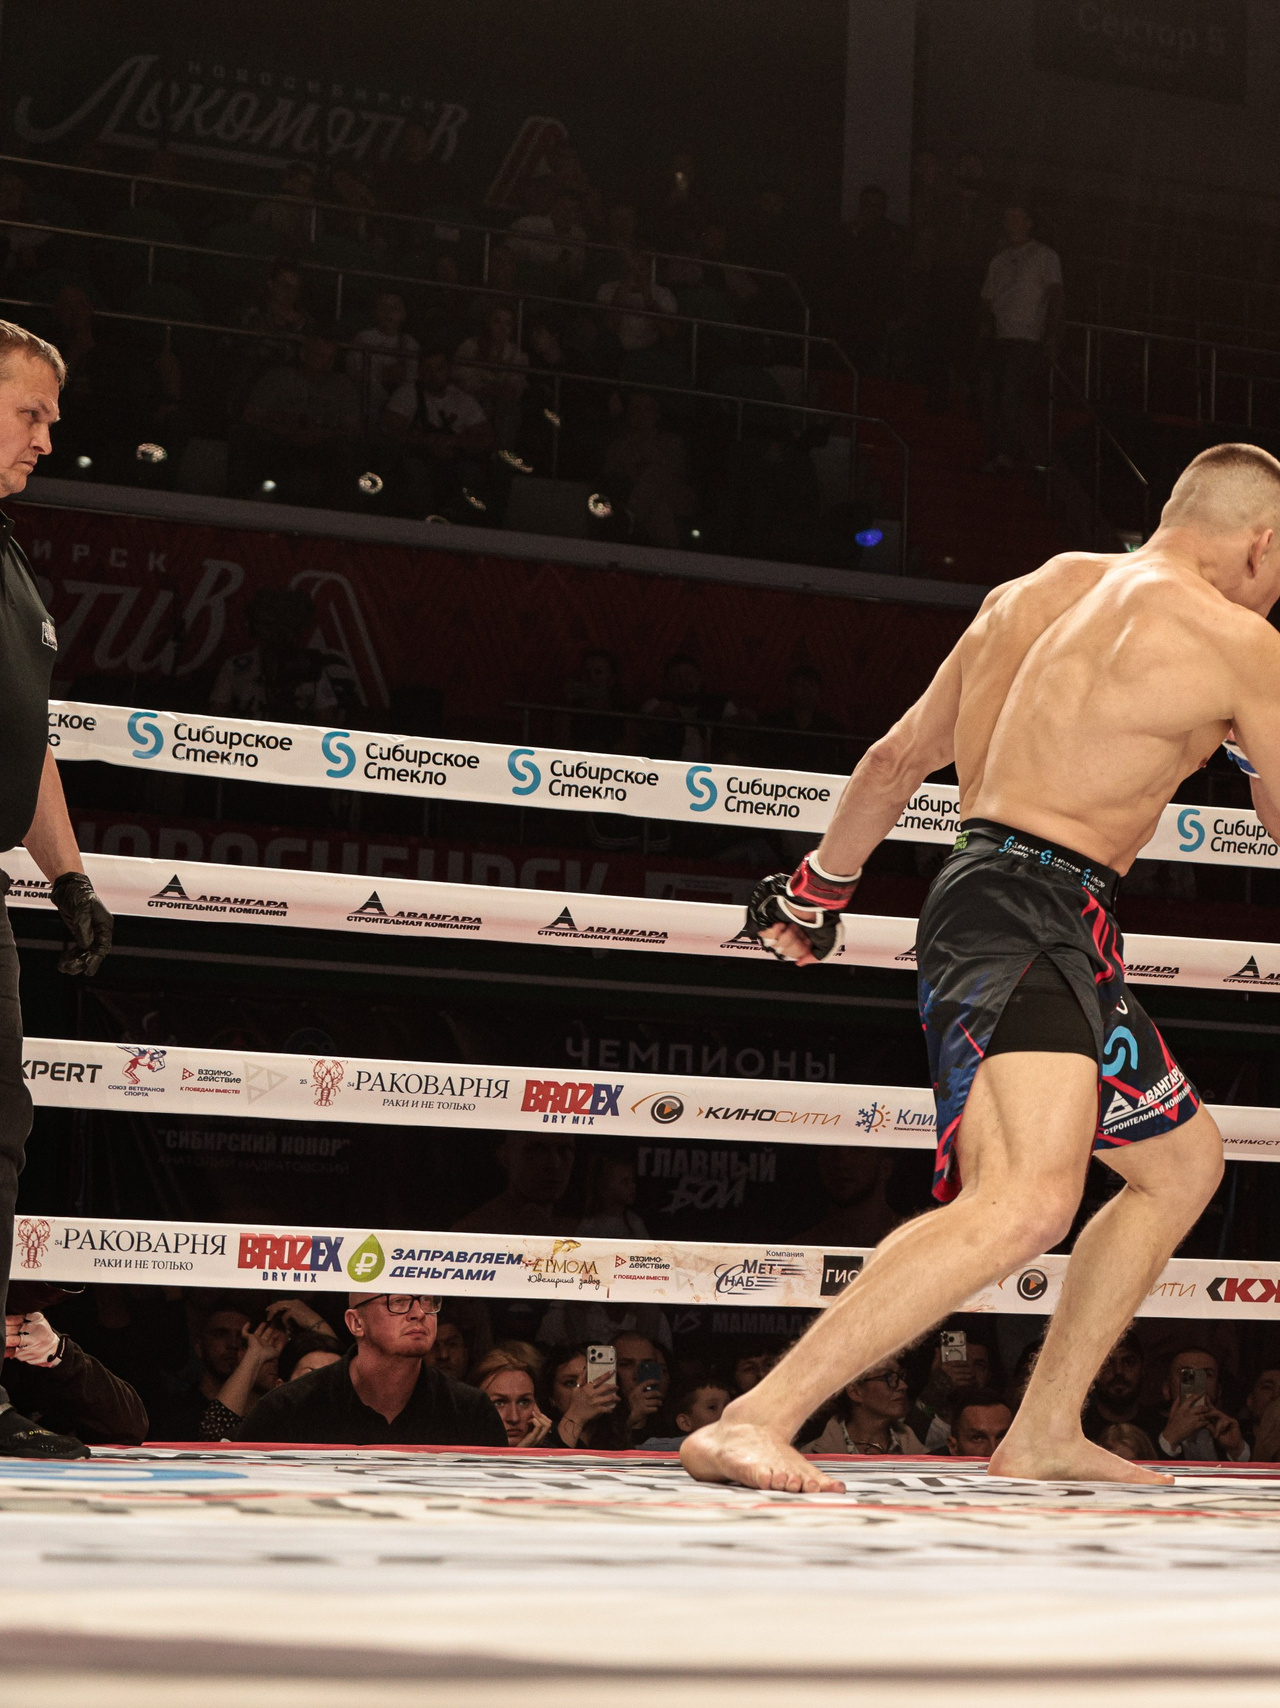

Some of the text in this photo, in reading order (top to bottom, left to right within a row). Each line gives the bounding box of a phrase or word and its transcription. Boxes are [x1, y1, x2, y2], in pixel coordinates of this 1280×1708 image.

[174, 723, 293, 751] Сибирское
[172, 742, 259, 768] Стекло
[366, 743, 480, 770] Сибирское
[364, 762, 447, 787] Стекло
[550, 759, 659, 787] Сибирское
[548, 779, 627, 802] Стекло
[726, 776, 831, 802] Сибирское
[724, 796, 801, 819] Стекло
[1210, 837, 1279, 856] Стекло
[147, 901, 287, 916] СТРОИТЕЛЬНАЯ КОМПАНИЯ
[346, 915, 481, 930] СТРОИТЕЛЬНАЯ КОМПАНИЯ
[537, 929, 666, 944] СТРОИТЕЛЬНАЯ КОМПАНИЯ
[566, 1037, 836, 1081] ЧЕМПИОНЫ
[354, 1070, 510, 1099] РАКОВАРНЯ
[382, 1098, 476, 1111] РАКИ И НЕ ТОЛЬКО
[520, 1079, 623, 1117] BROZEX
[543, 1114, 595, 1125] DRY MIX
[704, 1106, 841, 1126] КИНОСИТИ
[1103, 1104, 1165, 1135] СТРОИТЕЛЬНАЯ
[637, 1145, 777, 1182] ГЛАВНЫЙ
[63, 1227, 227, 1256] РАКОВАРНЯ
[238, 1232, 343, 1272] BROZEX
[94, 1258, 194, 1271] РАКИ И НЕ ТОЛЬКО
[391, 1248, 523, 1265] ЗАПРАВЛЯЕМ
[766, 1250, 804, 1258] Компания
[262, 1271, 317, 1283] DRY MIX
[389, 1266, 496, 1282] ДЕНЬГАМИ
